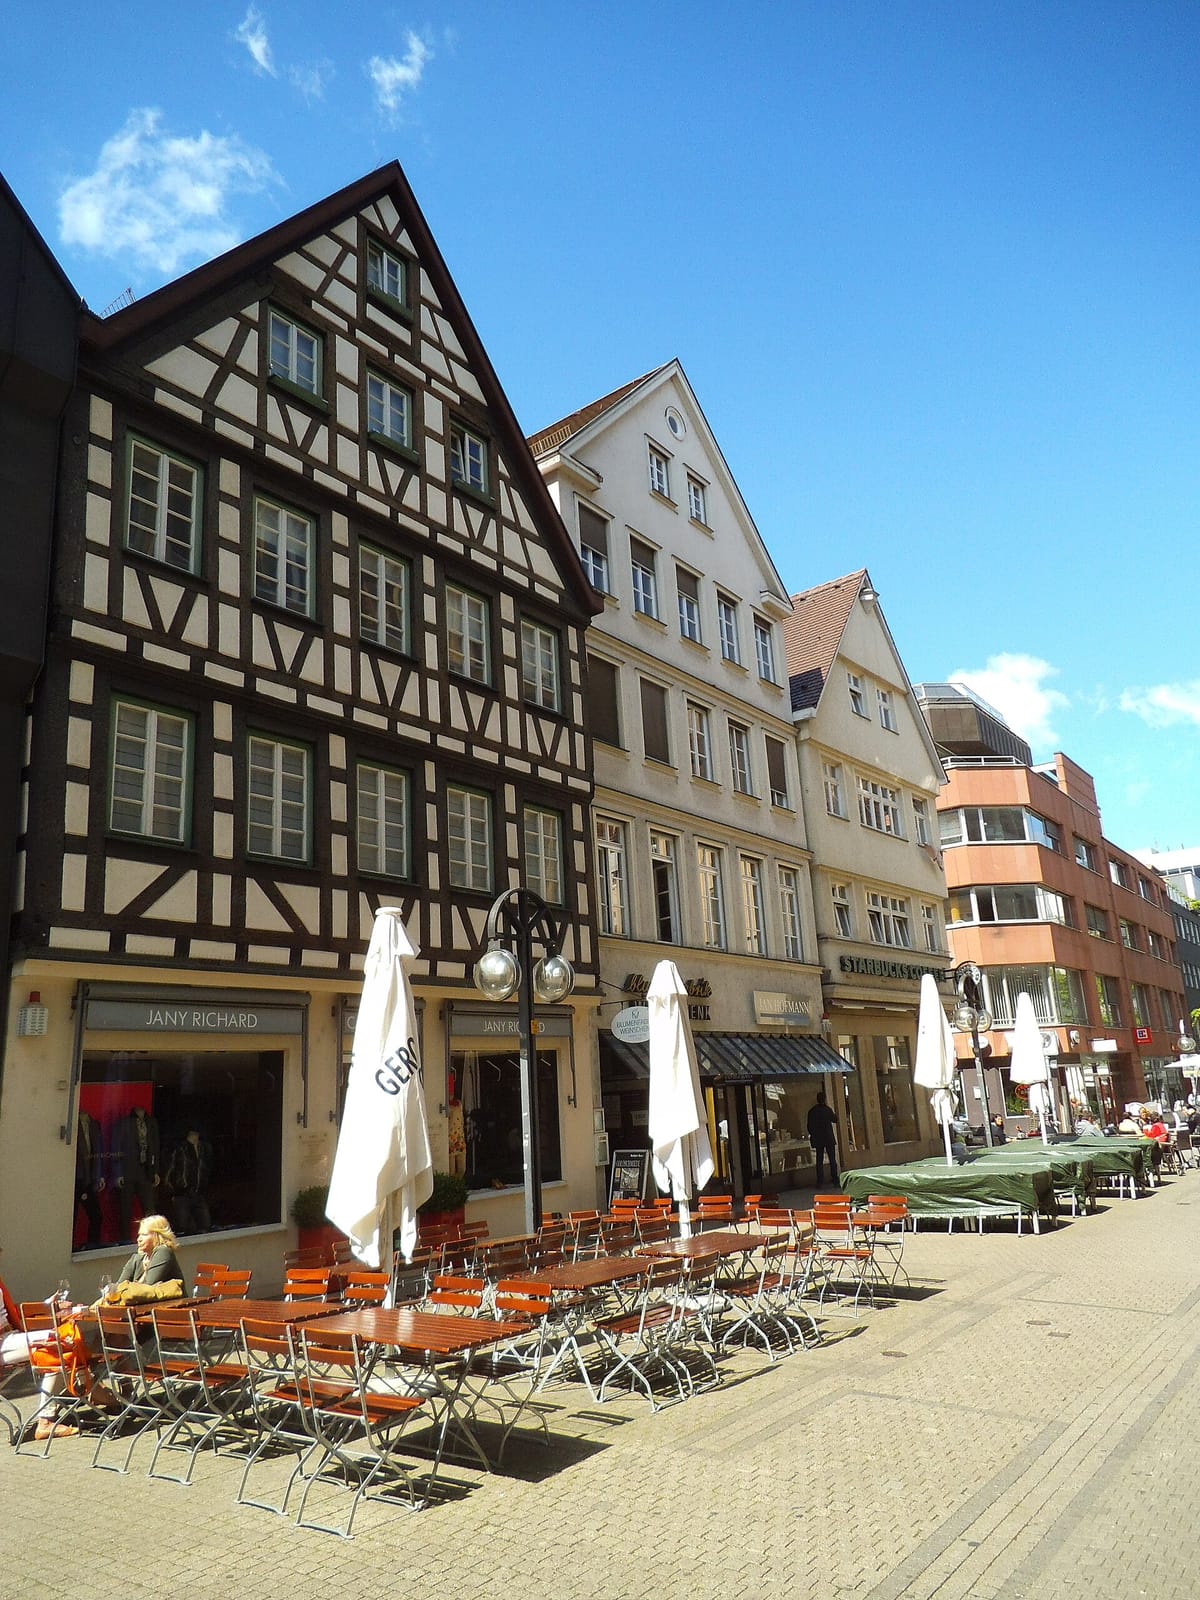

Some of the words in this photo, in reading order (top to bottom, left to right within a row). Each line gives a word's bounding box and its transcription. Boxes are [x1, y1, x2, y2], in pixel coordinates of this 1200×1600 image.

[842, 956, 908, 980] STARBUCKS
[145, 1009, 188, 1026] JANY
[192, 1011, 258, 1028] RICHARD
[483, 1020, 505, 1032] JANY
